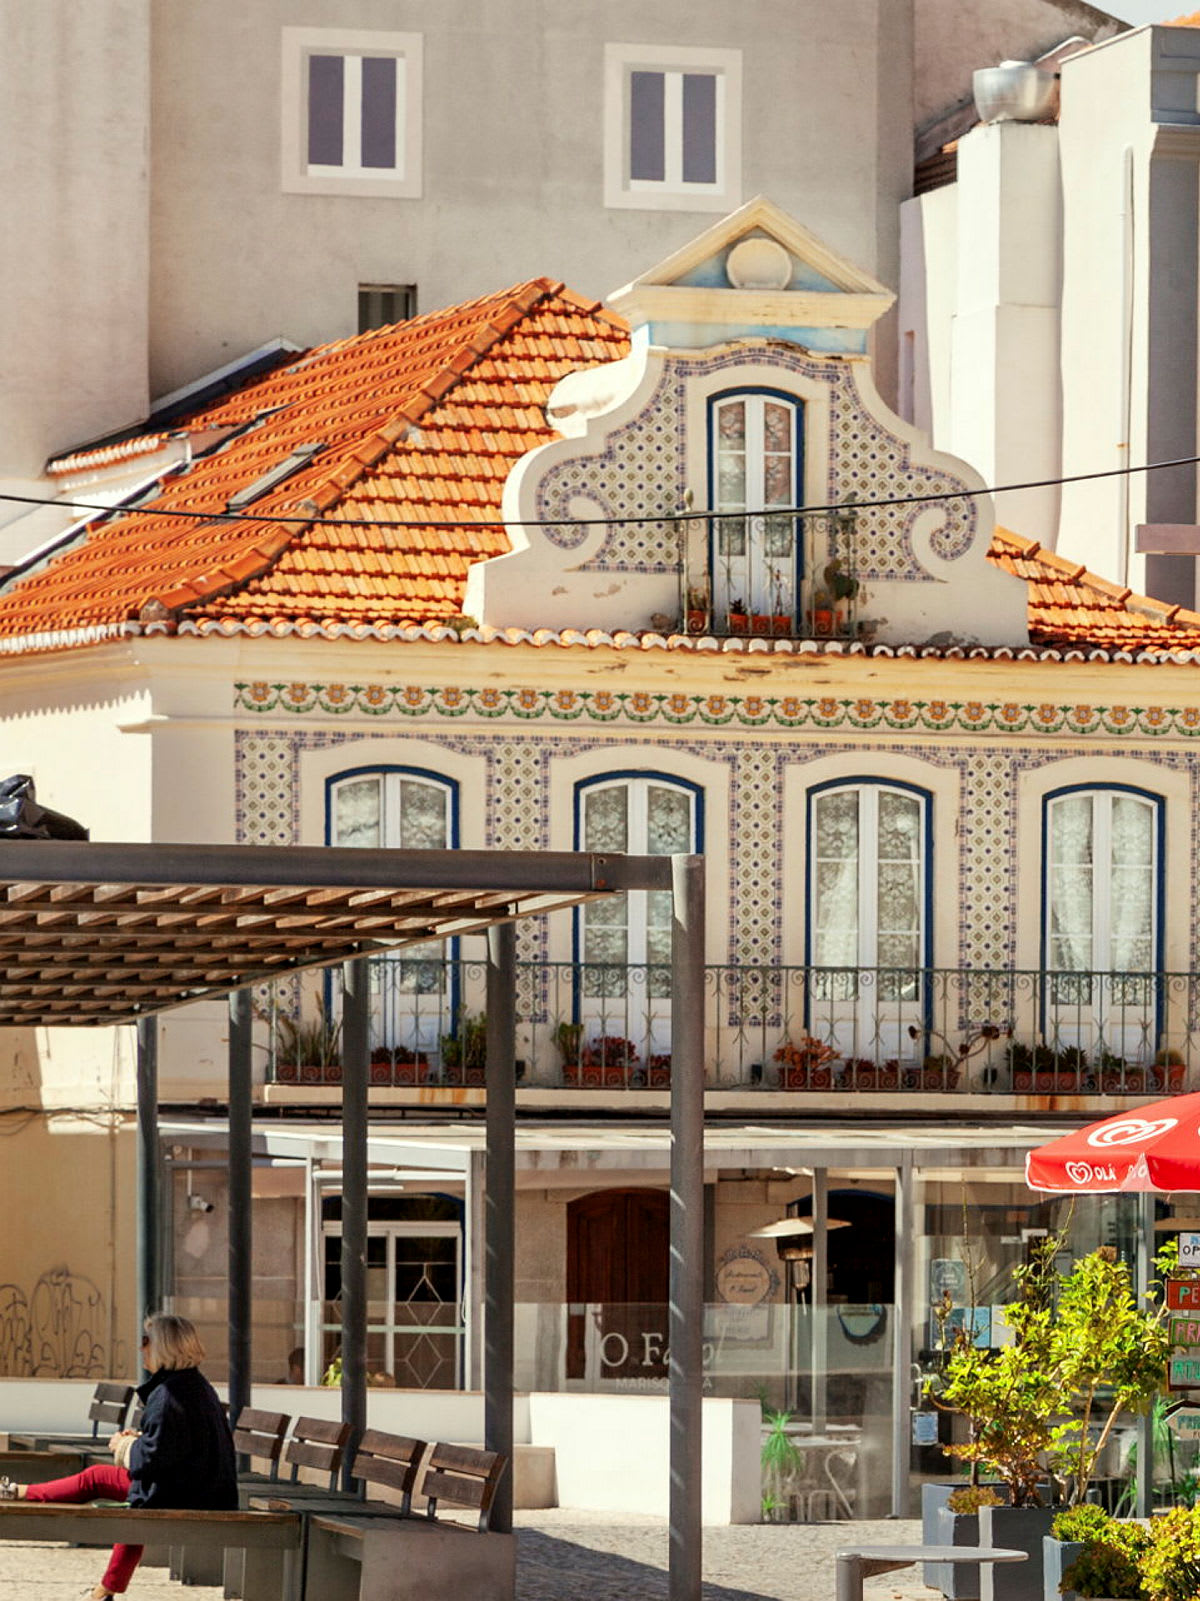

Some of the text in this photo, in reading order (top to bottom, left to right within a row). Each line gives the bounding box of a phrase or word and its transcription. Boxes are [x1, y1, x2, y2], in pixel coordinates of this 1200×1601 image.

[1094, 1164, 1117, 1181] OLÁ
[1183, 1245, 1191, 1256] O
[599, 1332, 628, 1367] O
